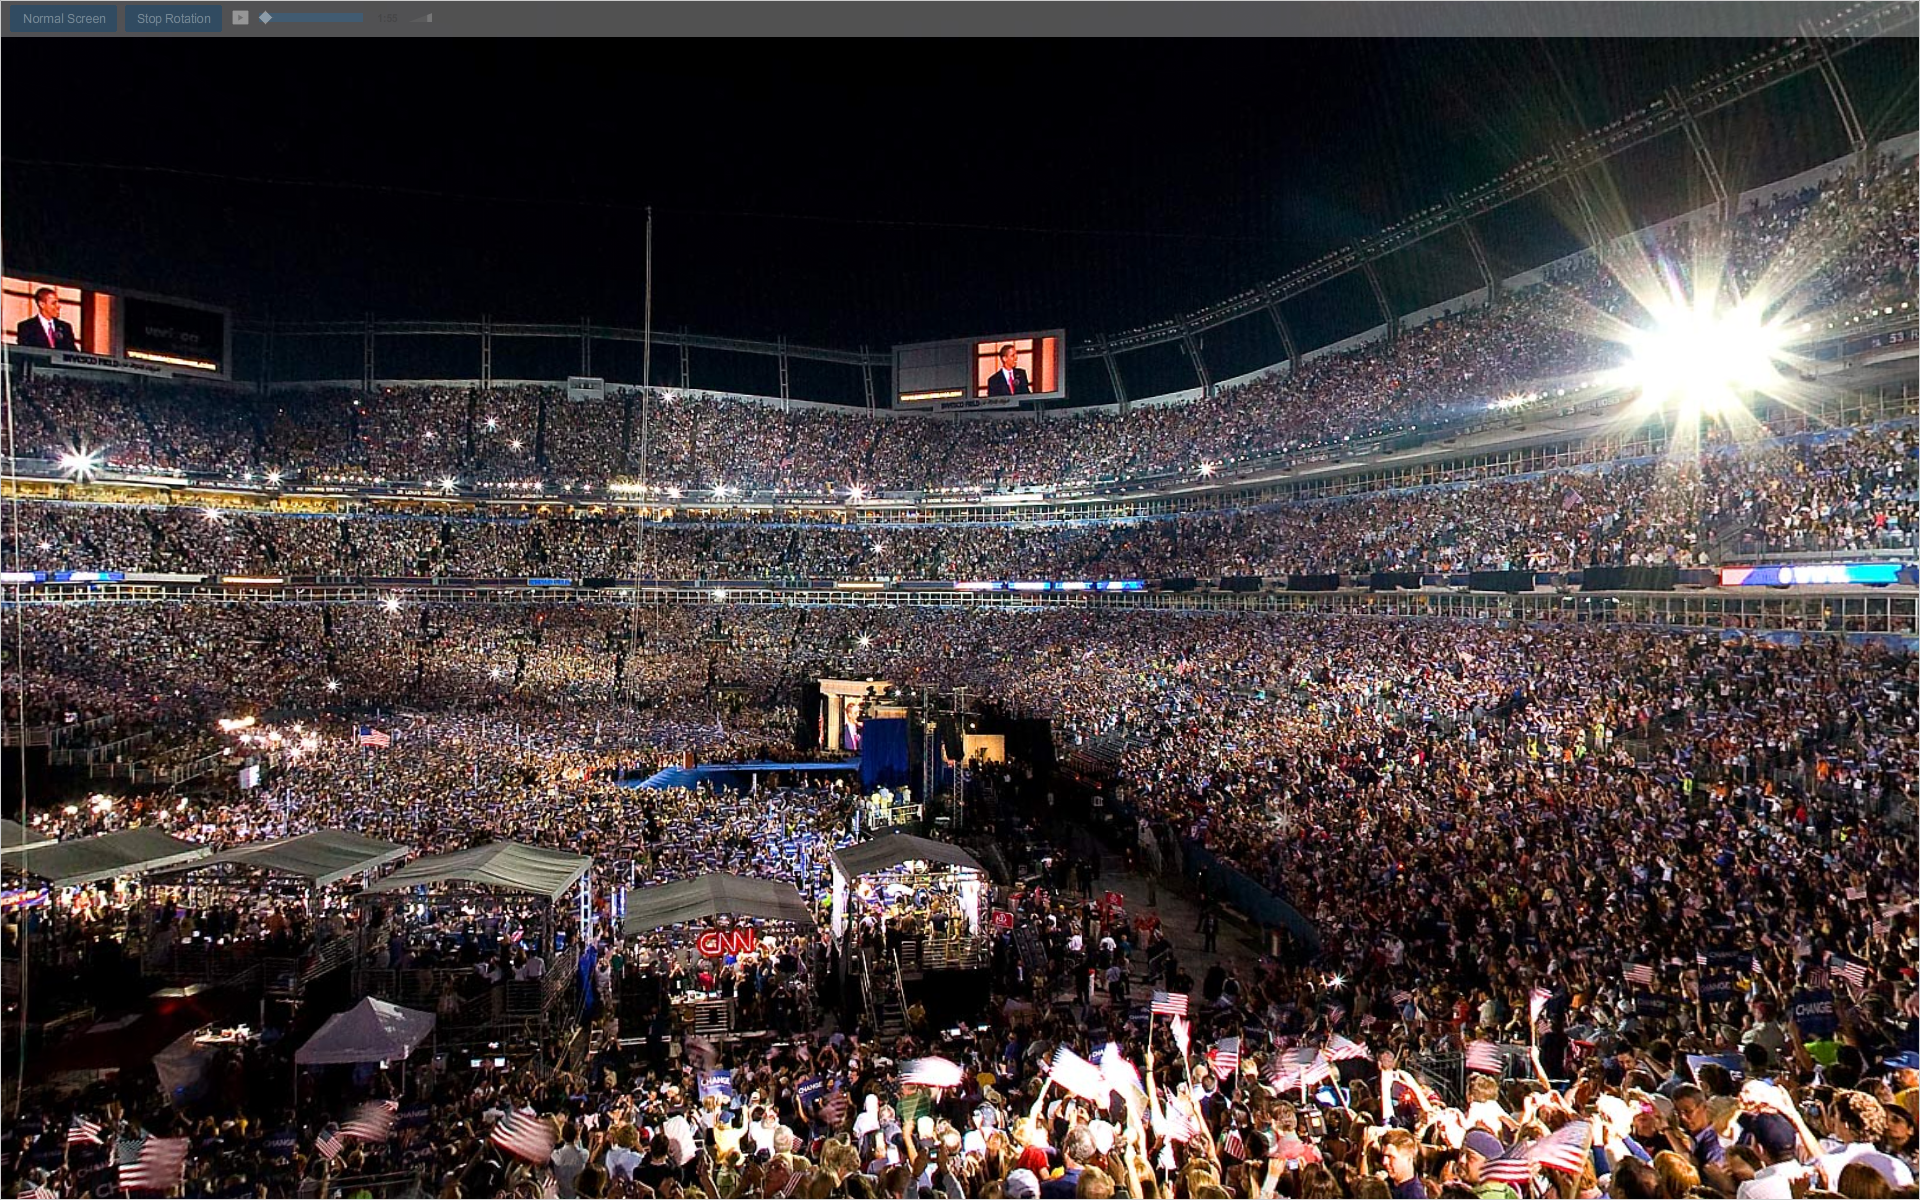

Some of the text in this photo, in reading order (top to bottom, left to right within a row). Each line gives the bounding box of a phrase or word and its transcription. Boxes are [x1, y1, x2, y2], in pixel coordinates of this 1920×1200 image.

[145, 325, 199, 344] verion
[697, 927, 754, 957] CNN
[1795, 1001, 1834, 1016] CHANGE
[700, 1075, 731, 1087] CHANGE
[798, 1081, 824, 1095] CHANGE
